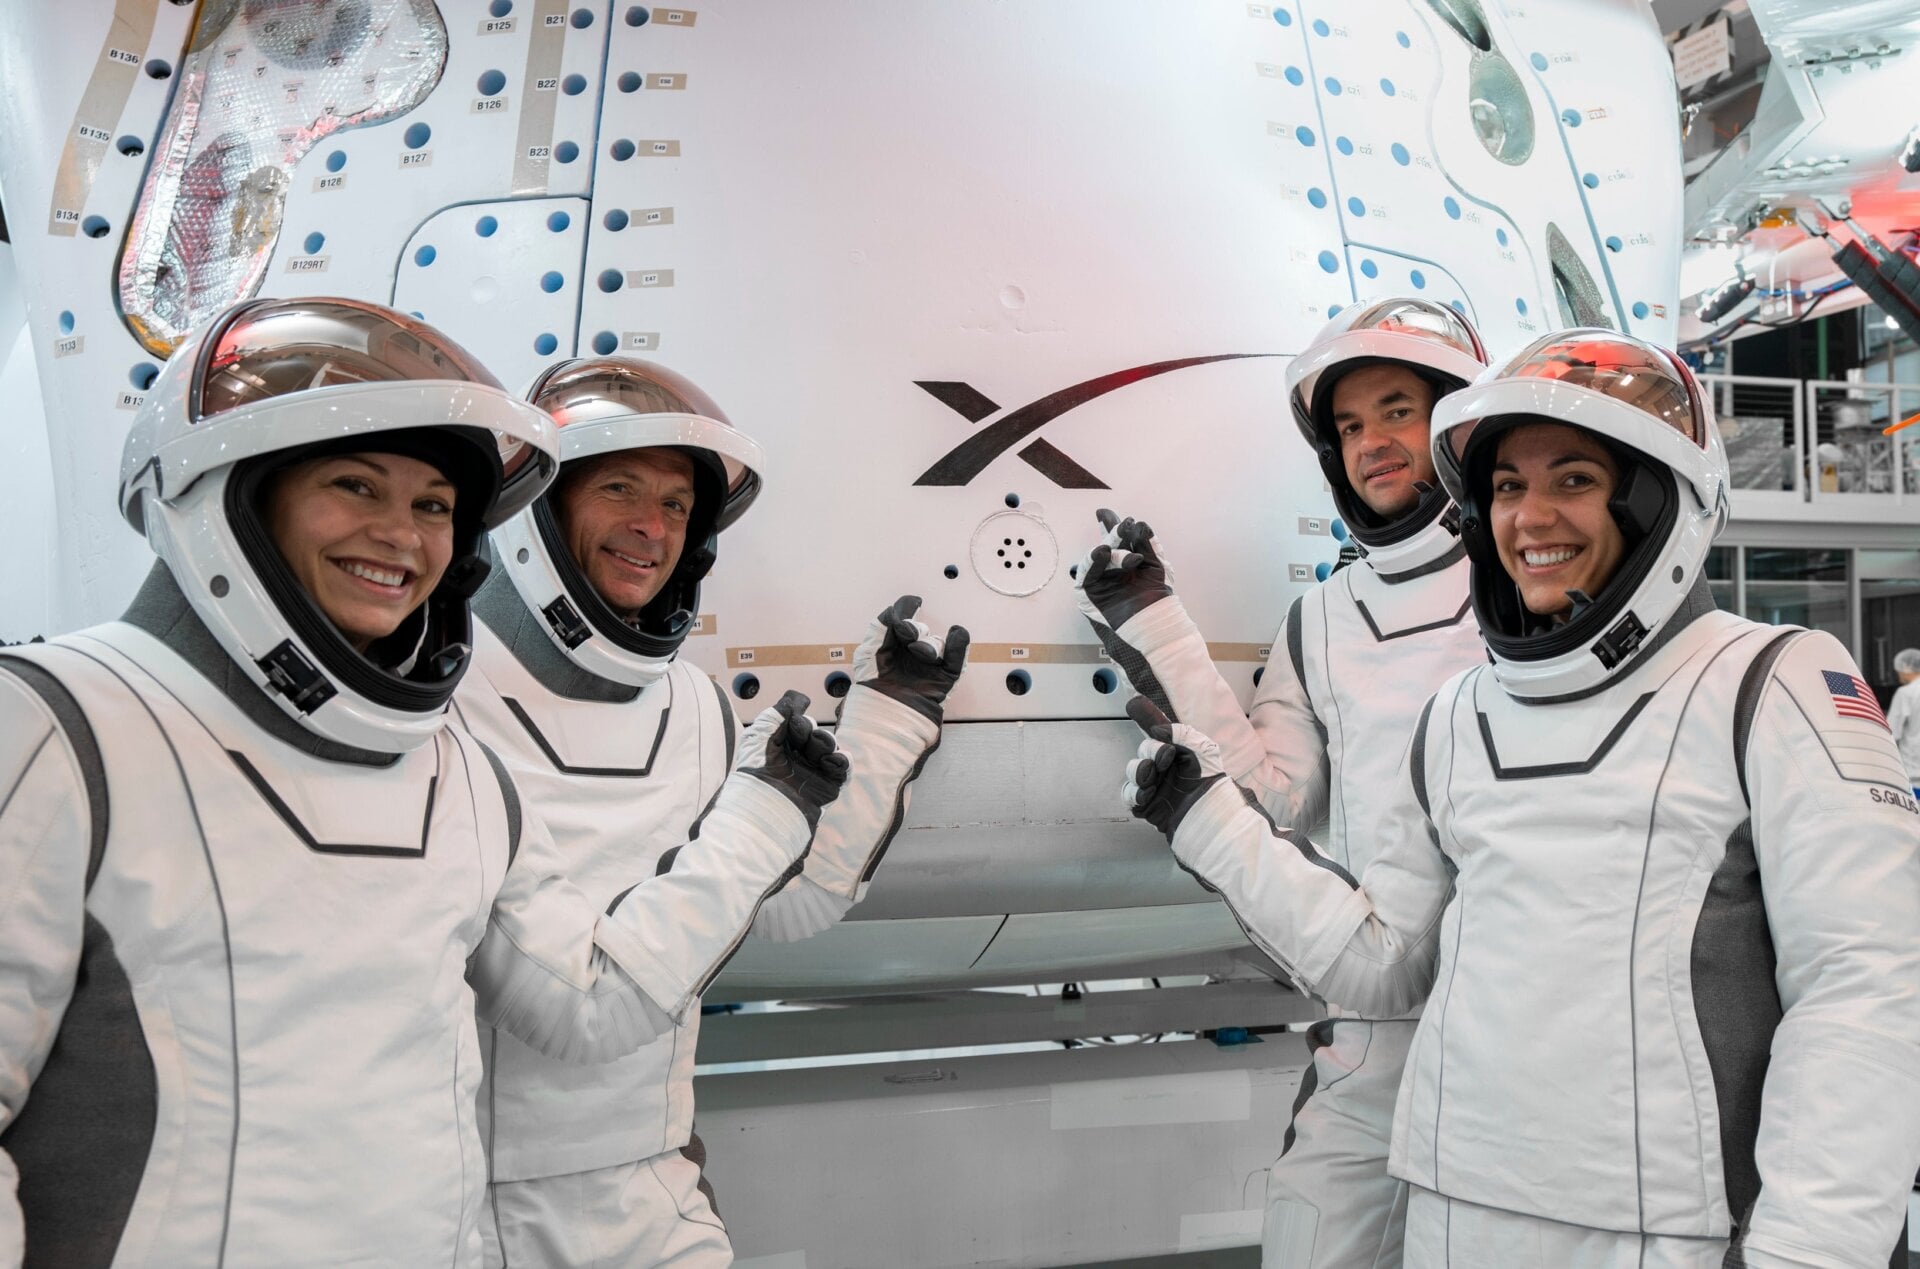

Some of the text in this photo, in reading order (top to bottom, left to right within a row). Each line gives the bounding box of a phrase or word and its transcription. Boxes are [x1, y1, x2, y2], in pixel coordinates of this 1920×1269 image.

[545, 16, 564, 25] B21
[486, 21, 512, 31] B125
[109, 49, 139, 64] B136
[537, 80, 556, 89] B22
[477, 100, 501, 110] B126
[80, 127, 109, 141] B135
[529, 148, 549, 157] B23
[403, 153, 427, 164] B127
[319, 178, 342, 188] B128
[56, 210, 79, 221] B134
[291, 260, 324, 270] B129RT
[830, 650, 843, 659] E38
[1012, 648, 1024, 656] E36
